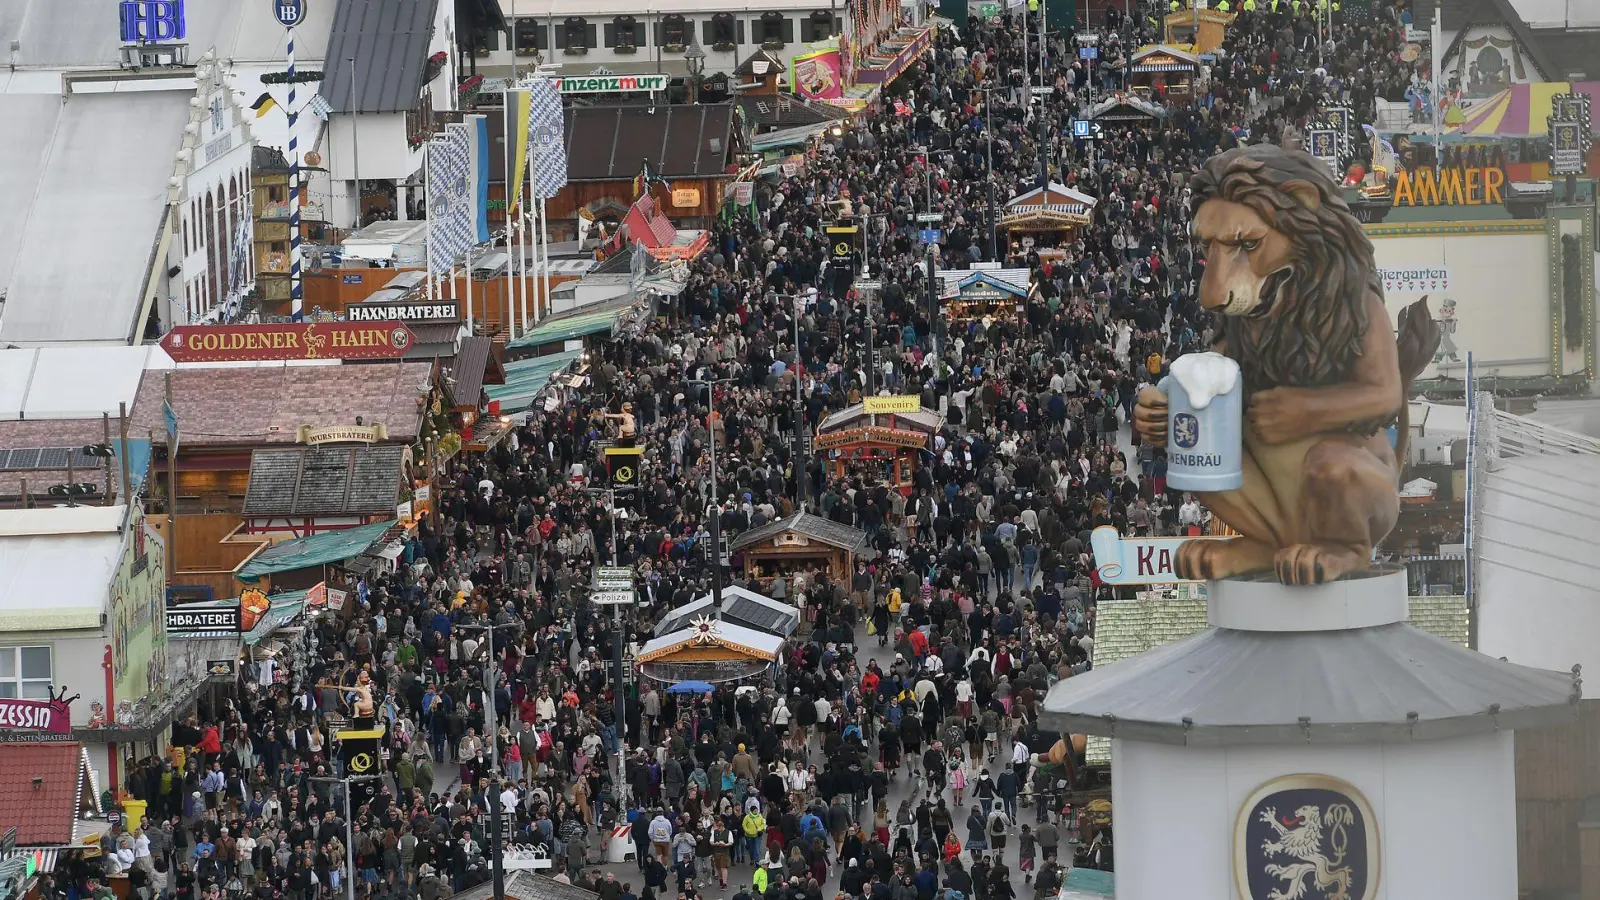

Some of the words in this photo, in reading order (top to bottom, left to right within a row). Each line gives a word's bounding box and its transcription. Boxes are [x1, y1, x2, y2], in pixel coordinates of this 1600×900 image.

[281, 6, 296, 21] HB
[121, 1, 178, 41] HB
[1077, 123, 1087, 133] U
[1393, 166, 1504, 207] AMMER
[1376, 268, 1447, 282] Biergarten
[349, 304, 457, 322] HAXNBRATEREI
[188, 332, 299, 351] GOLDENER
[331, 329, 389, 347] HAHN
[869, 400, 914, 409] Souvenirs
[310, 432, 374, 442] WURSTBRATEREI
[818, 435, 860, 447] Souvenirs
[601, 593, 629, 601] Polizei
